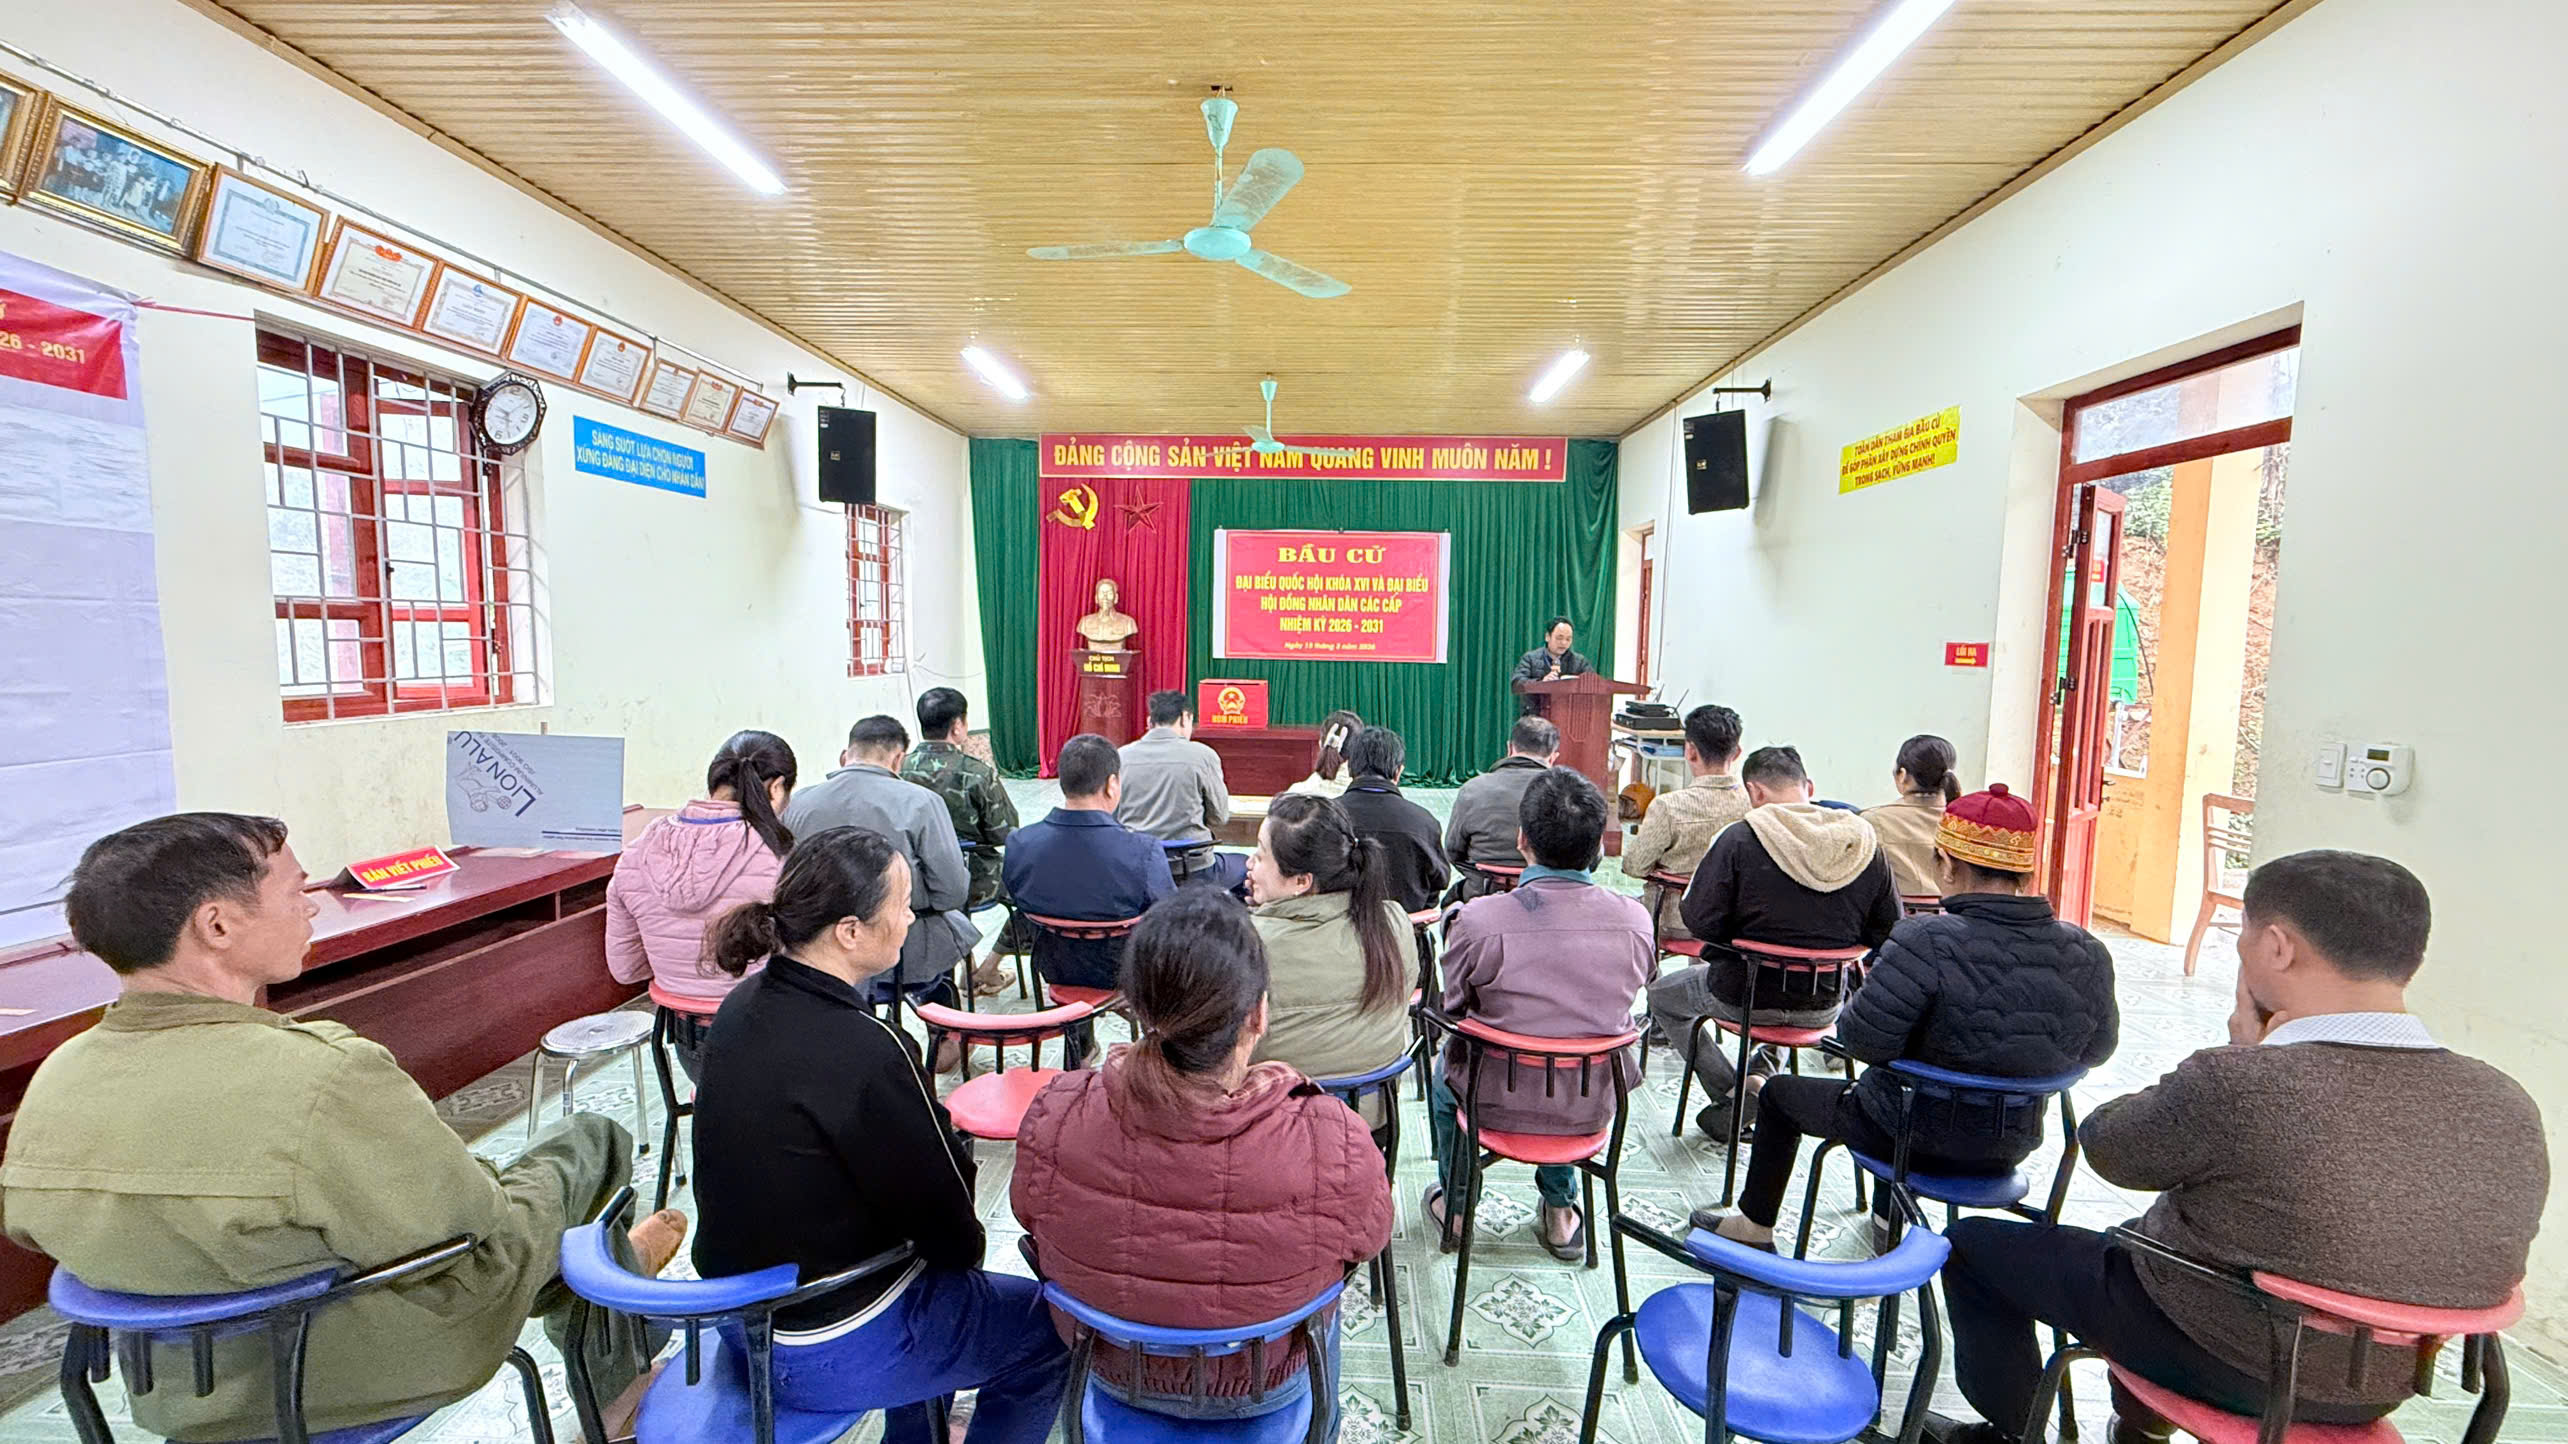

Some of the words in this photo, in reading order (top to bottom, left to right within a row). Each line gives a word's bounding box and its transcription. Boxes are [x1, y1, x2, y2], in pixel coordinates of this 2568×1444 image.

[0, 331, 23, 350] 26
[40, 341, 86, 365] 2031
[1054, 437, 1105, 467] ĐẢNG
[1111, 440, 1161, 471] CỘNG
[1168, 438, 1207, 468] SẢN
[1213, 441, 1253, 472] VIỆT
[1260, 446, 1303, 468] NAM
[1310, 447, 1374, 470] QUANG
[1380, 447, 1424, 470] VINH
[1432, 443, 1488, 470] MUÔN
[1494, 443, 1539, 470] NĂM
[1544, 449, 1552, 470] !
[1346, 545, 1386, 564] CỬ
[1235, 575, 1252, 592] ĐẠI
[1279, 572, 1305, 592] QUỐC
[1307, 573, 1323, 593] HỘI
[1353, 577, 1370, 592] XVI
[1261, 593, 1277, 613] HỘI
[1328, 618, 1352, 632] 2026
[1361, 619, 1384, 633] 2031
[454, 731, 537, 817] LIONALU
